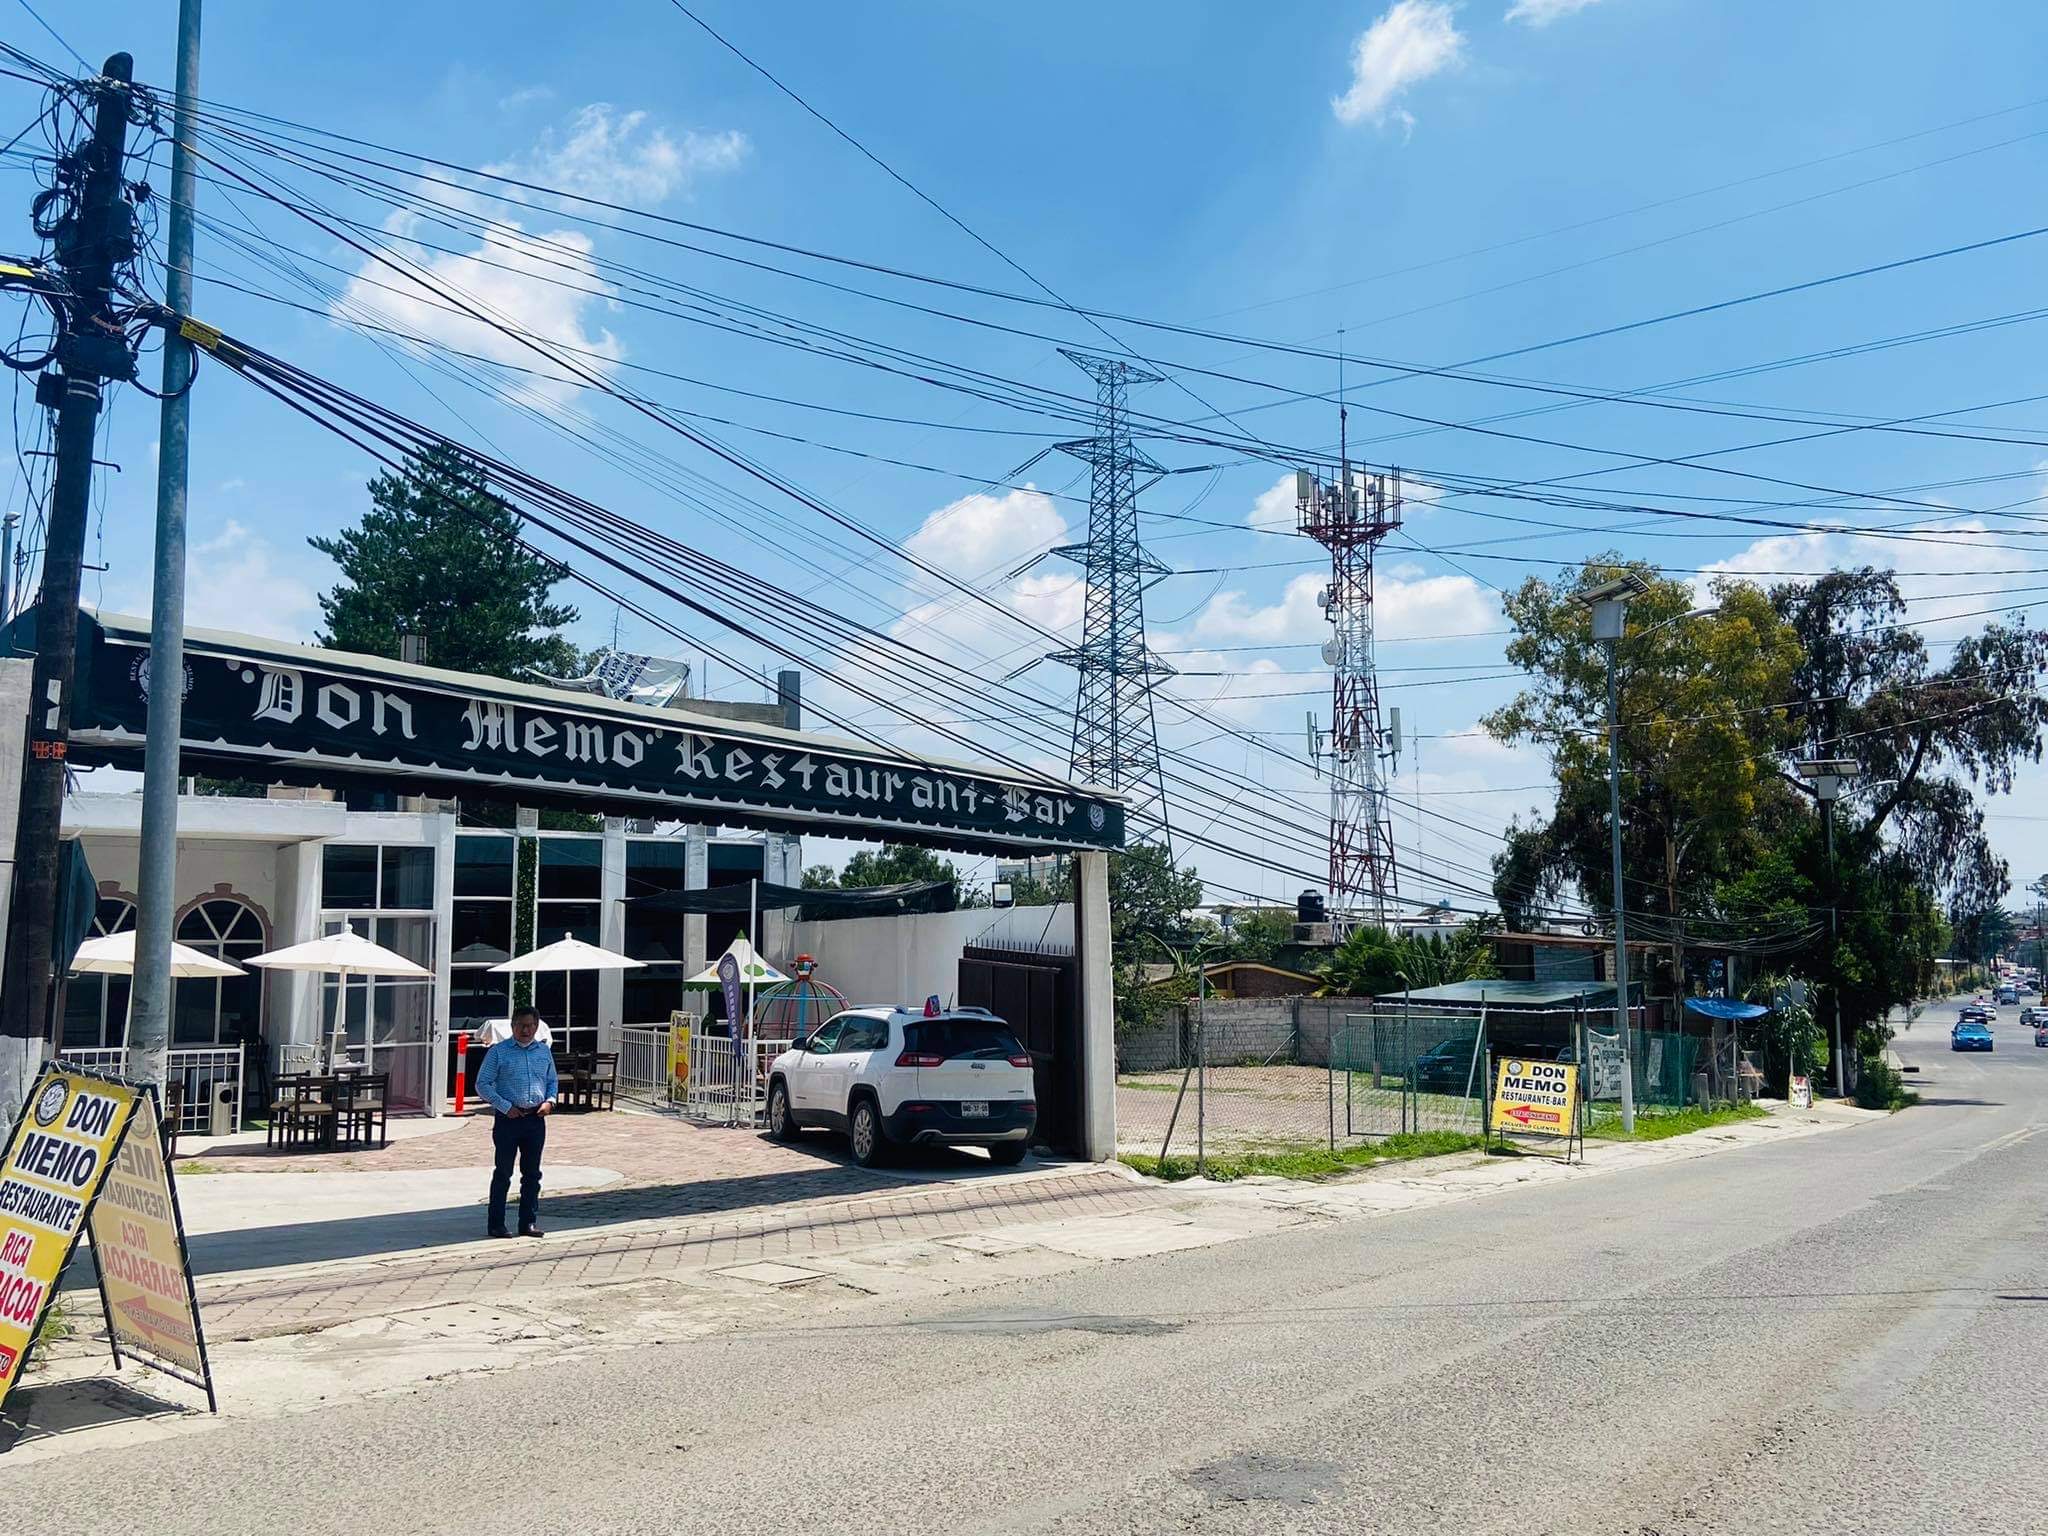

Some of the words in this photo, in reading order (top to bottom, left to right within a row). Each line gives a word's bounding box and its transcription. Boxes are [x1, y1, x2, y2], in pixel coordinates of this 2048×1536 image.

[1504, 1077, 1567, 1093] MEMO
[1532, 1066, 1566, 1079] DON
[66, 1094, 117, 1137] DON
[14, 1133, 98, 1187] MEMO
[0, 1180, 81, 1231] RESTAURANTE
[0, 1232, 32, 1268] RICA
[0, 1271, 43, 1326] ACOA
